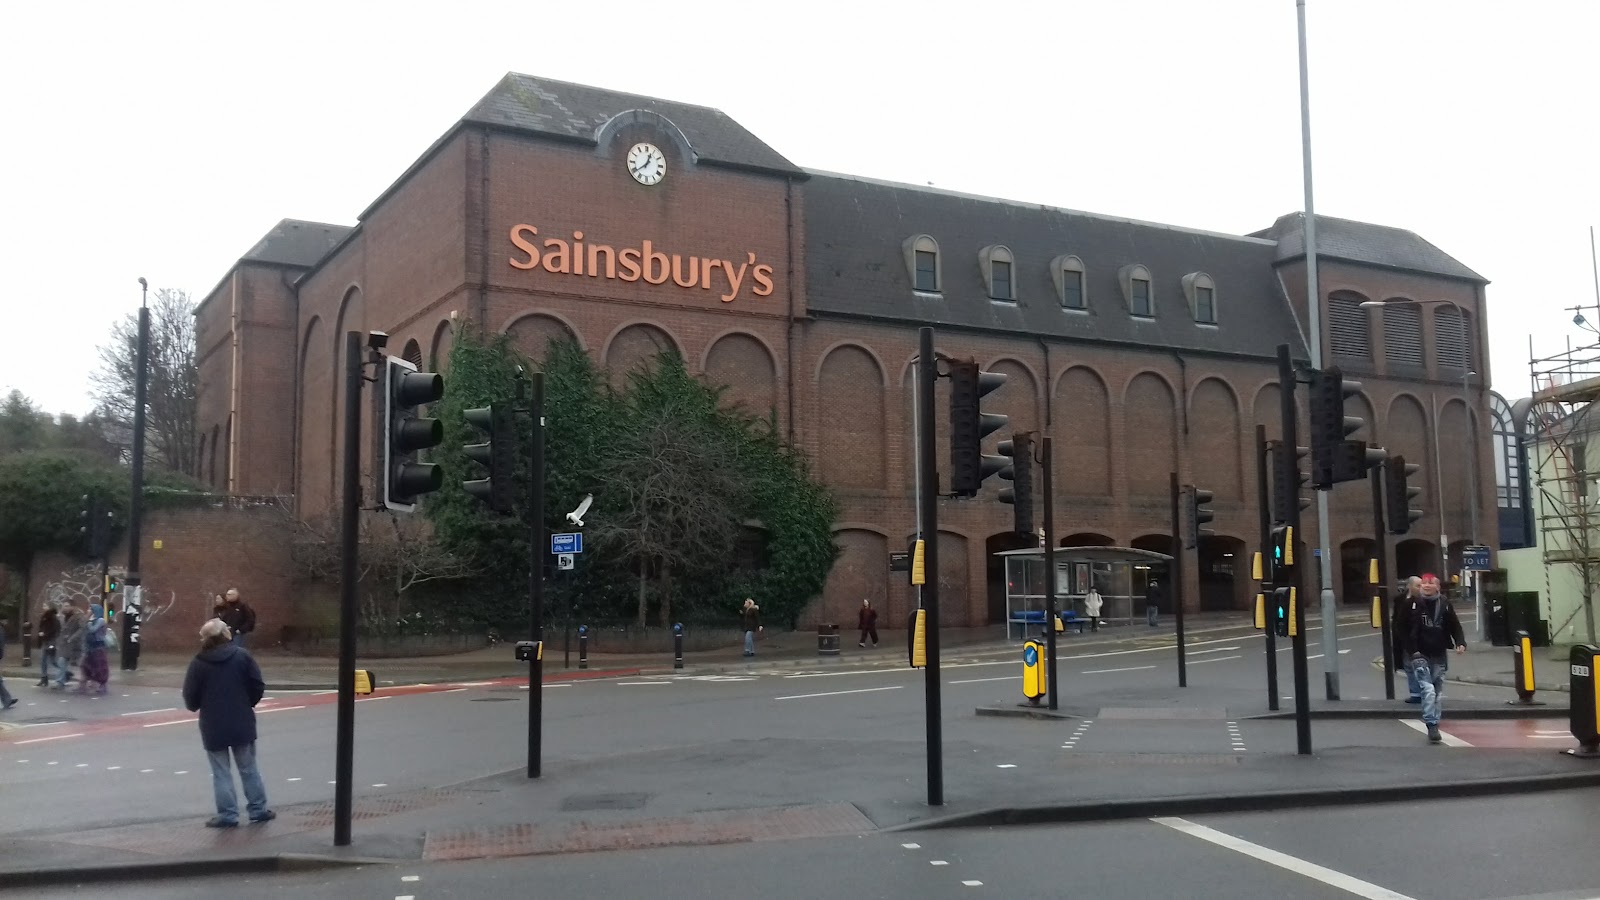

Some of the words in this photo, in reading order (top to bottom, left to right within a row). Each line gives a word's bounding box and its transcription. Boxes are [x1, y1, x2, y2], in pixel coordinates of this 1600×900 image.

[509, 223, 774, 302] Sainsbury's
[1463, 557, 1474, 565] TO
[1477, 557, 1489, 565] LET
